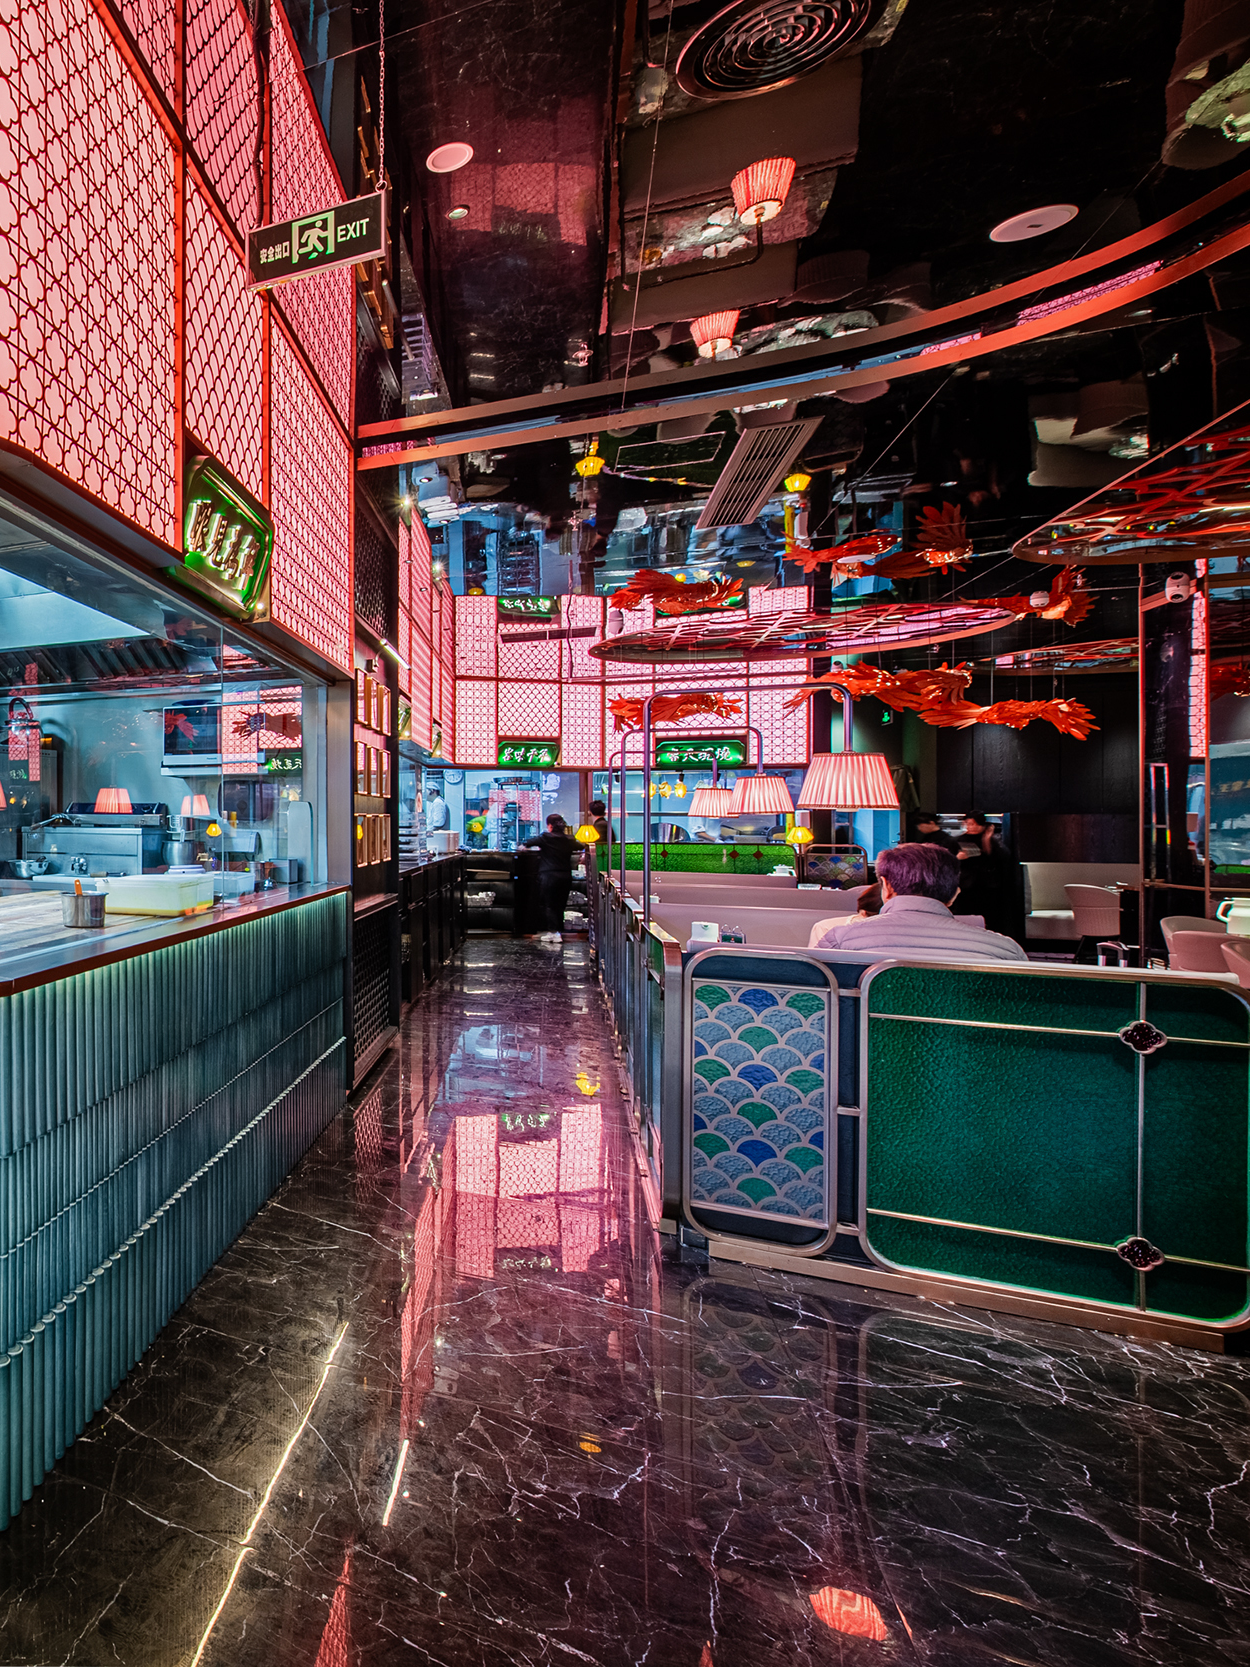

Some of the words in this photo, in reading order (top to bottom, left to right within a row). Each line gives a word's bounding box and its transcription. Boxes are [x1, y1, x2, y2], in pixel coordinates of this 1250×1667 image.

[337, 218, 370, 242] EXIT
[259, 241, 290, 264] 安全出口
